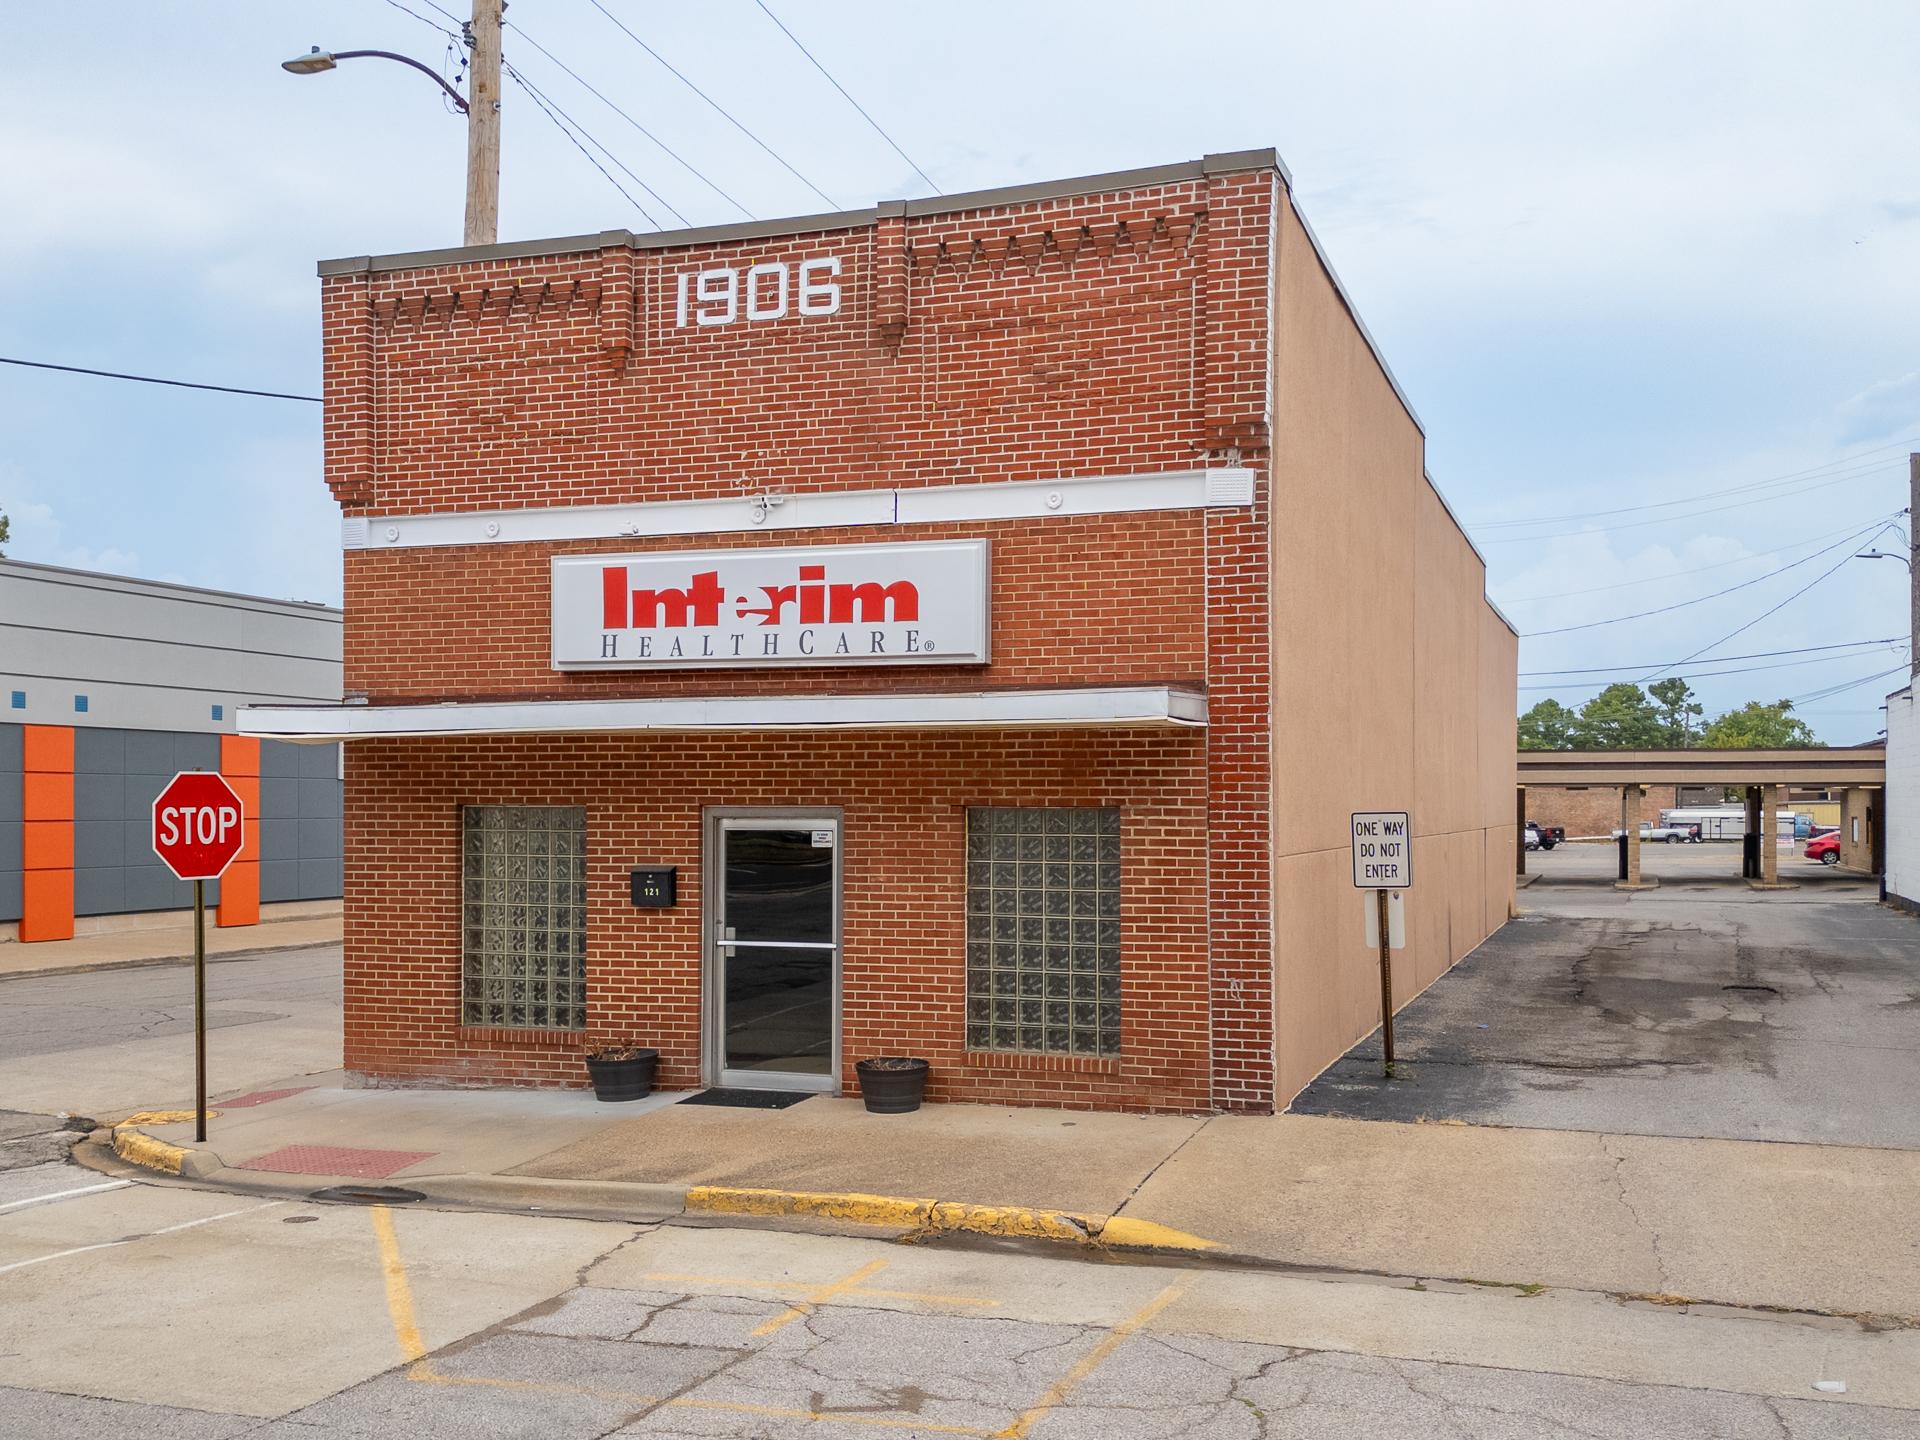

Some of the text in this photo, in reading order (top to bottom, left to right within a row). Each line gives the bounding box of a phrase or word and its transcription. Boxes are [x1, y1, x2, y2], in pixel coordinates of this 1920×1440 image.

[676, 257, 840, 327] 1906
[603, 566, 919, 629] Interim
[160, 806, 238, 846] STOP
[1355, 821, 1404, 836] ONE WAY
[1360, 843, 1401, 857] DO NOT
[1365, 864, 1398, 878] ENTER
[644, 887, 659, 896] 121
